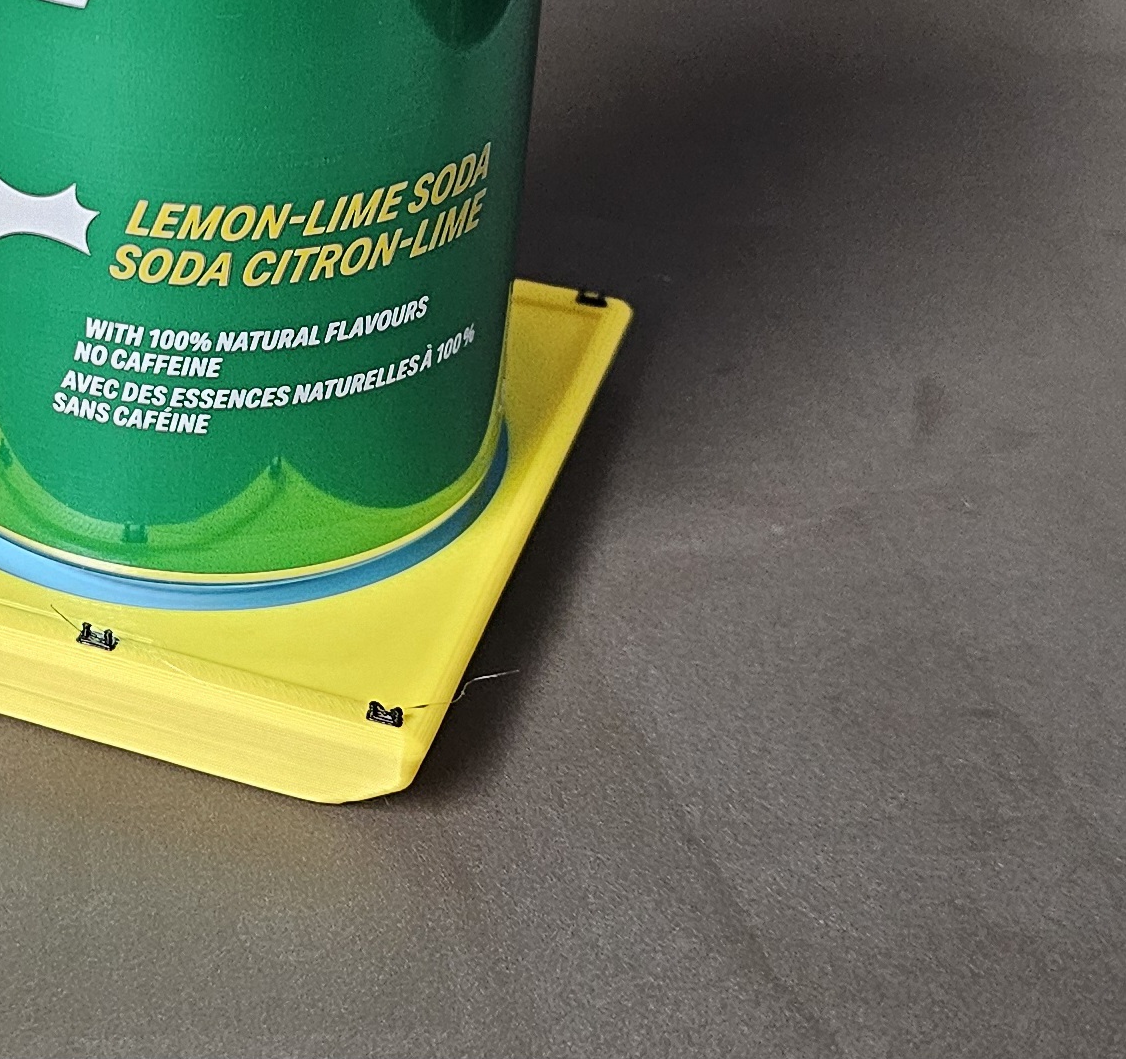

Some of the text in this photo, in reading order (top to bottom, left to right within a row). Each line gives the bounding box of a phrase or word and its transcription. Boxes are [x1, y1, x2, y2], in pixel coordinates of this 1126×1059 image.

[124, 141, 492, 242] LEMON-LIME SODA
[108, 187, 488, 287] SODA CITRON-LIME
[84, 295, 430, 353] WITH 100% NATURAL FLAVOURS
[60, 369, 120, 400] AVEC
[120, 381, 169, 408] DES
[169, 385, 291, 410] ESSENCES
[291, 354, 421, 406] NATURELLES
[73, 341, 224, 378] NO CAFFEINE
[52, 392, 212, 435] SANS CAFÉINE
